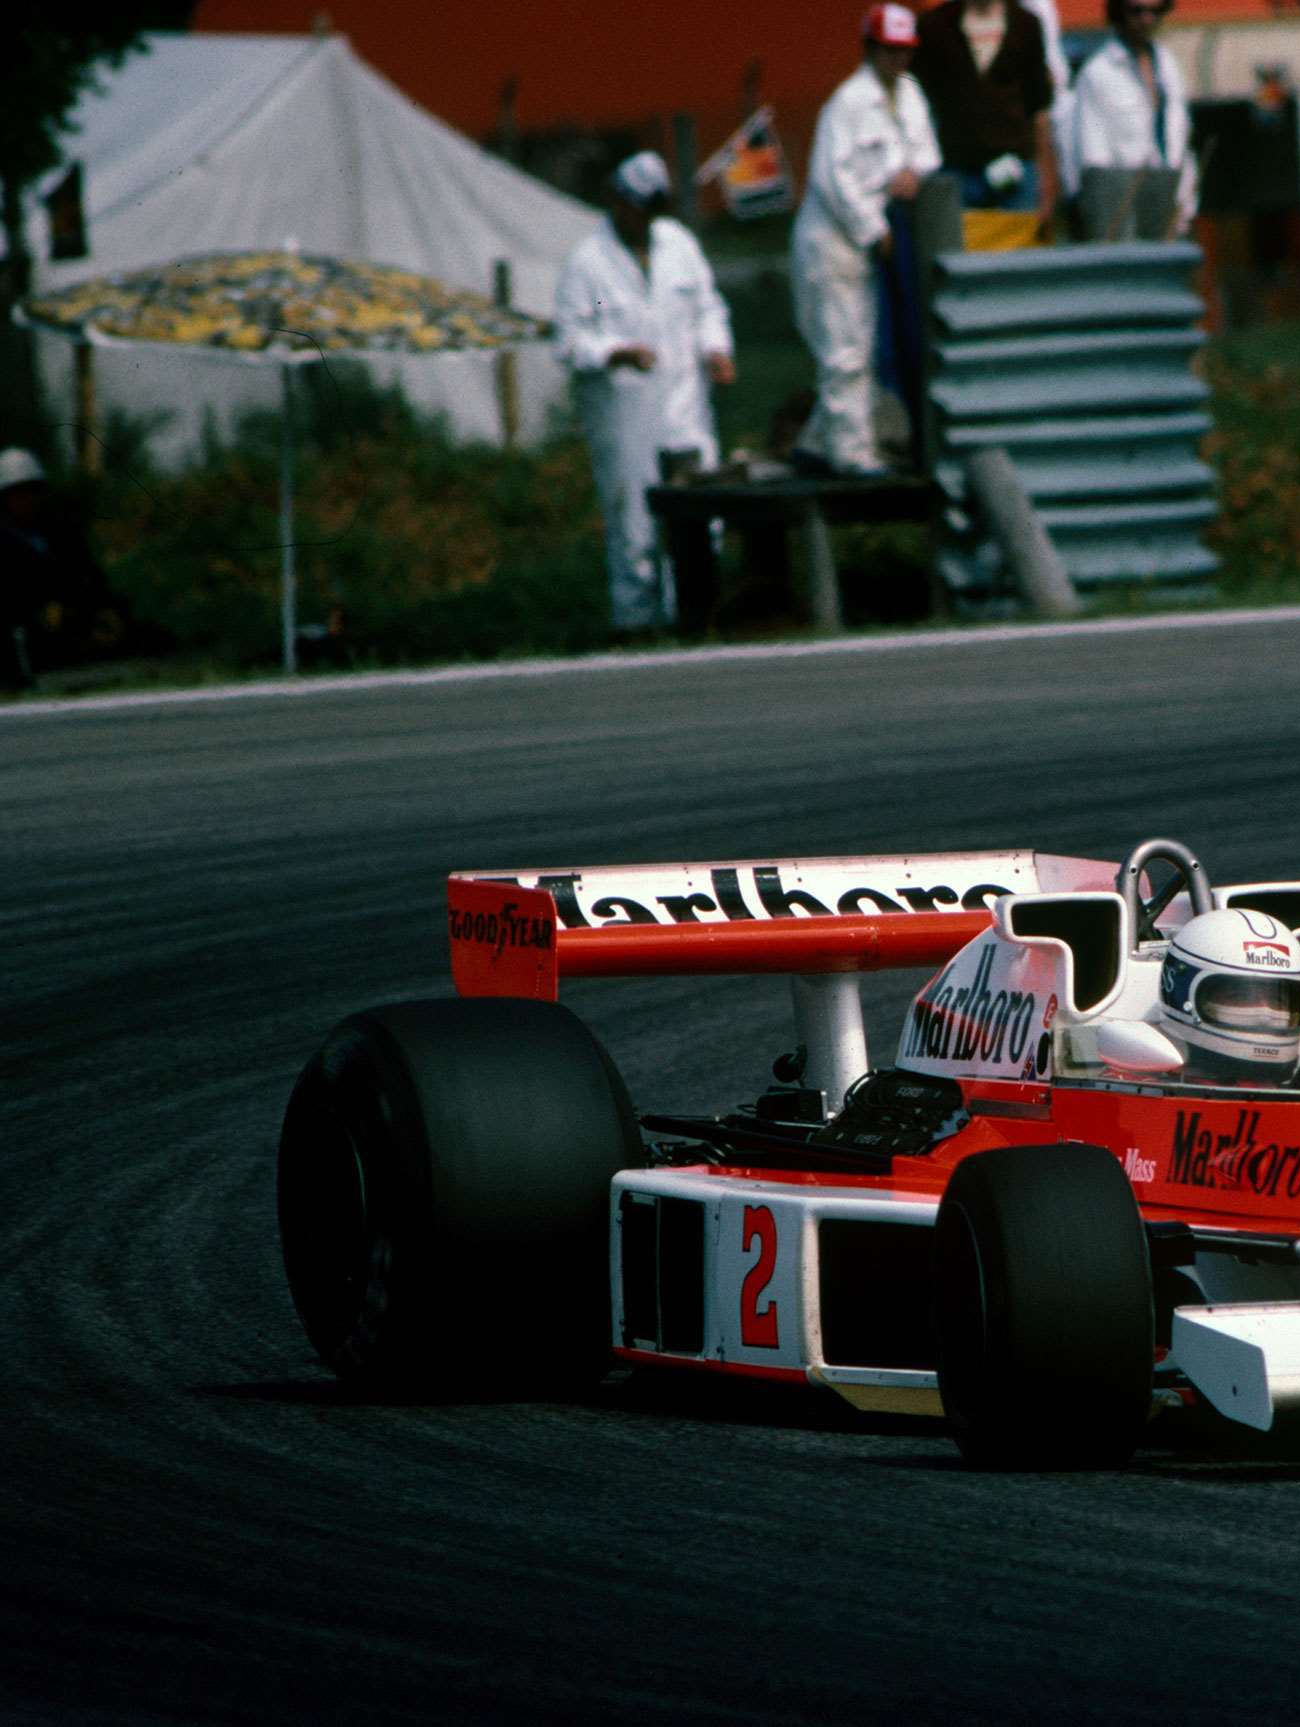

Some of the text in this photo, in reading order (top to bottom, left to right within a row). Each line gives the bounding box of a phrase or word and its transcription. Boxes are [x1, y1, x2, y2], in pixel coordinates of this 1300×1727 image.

[1246, 950, 1290, 968] Marlboro
[905, 944, 1035, 1065] Marlboro
[1253, 1047, 1279, 1056] TEXACO
[1124, 1148, 1157, 1182] Mass
[741, 1205, 779, 1349] 2
